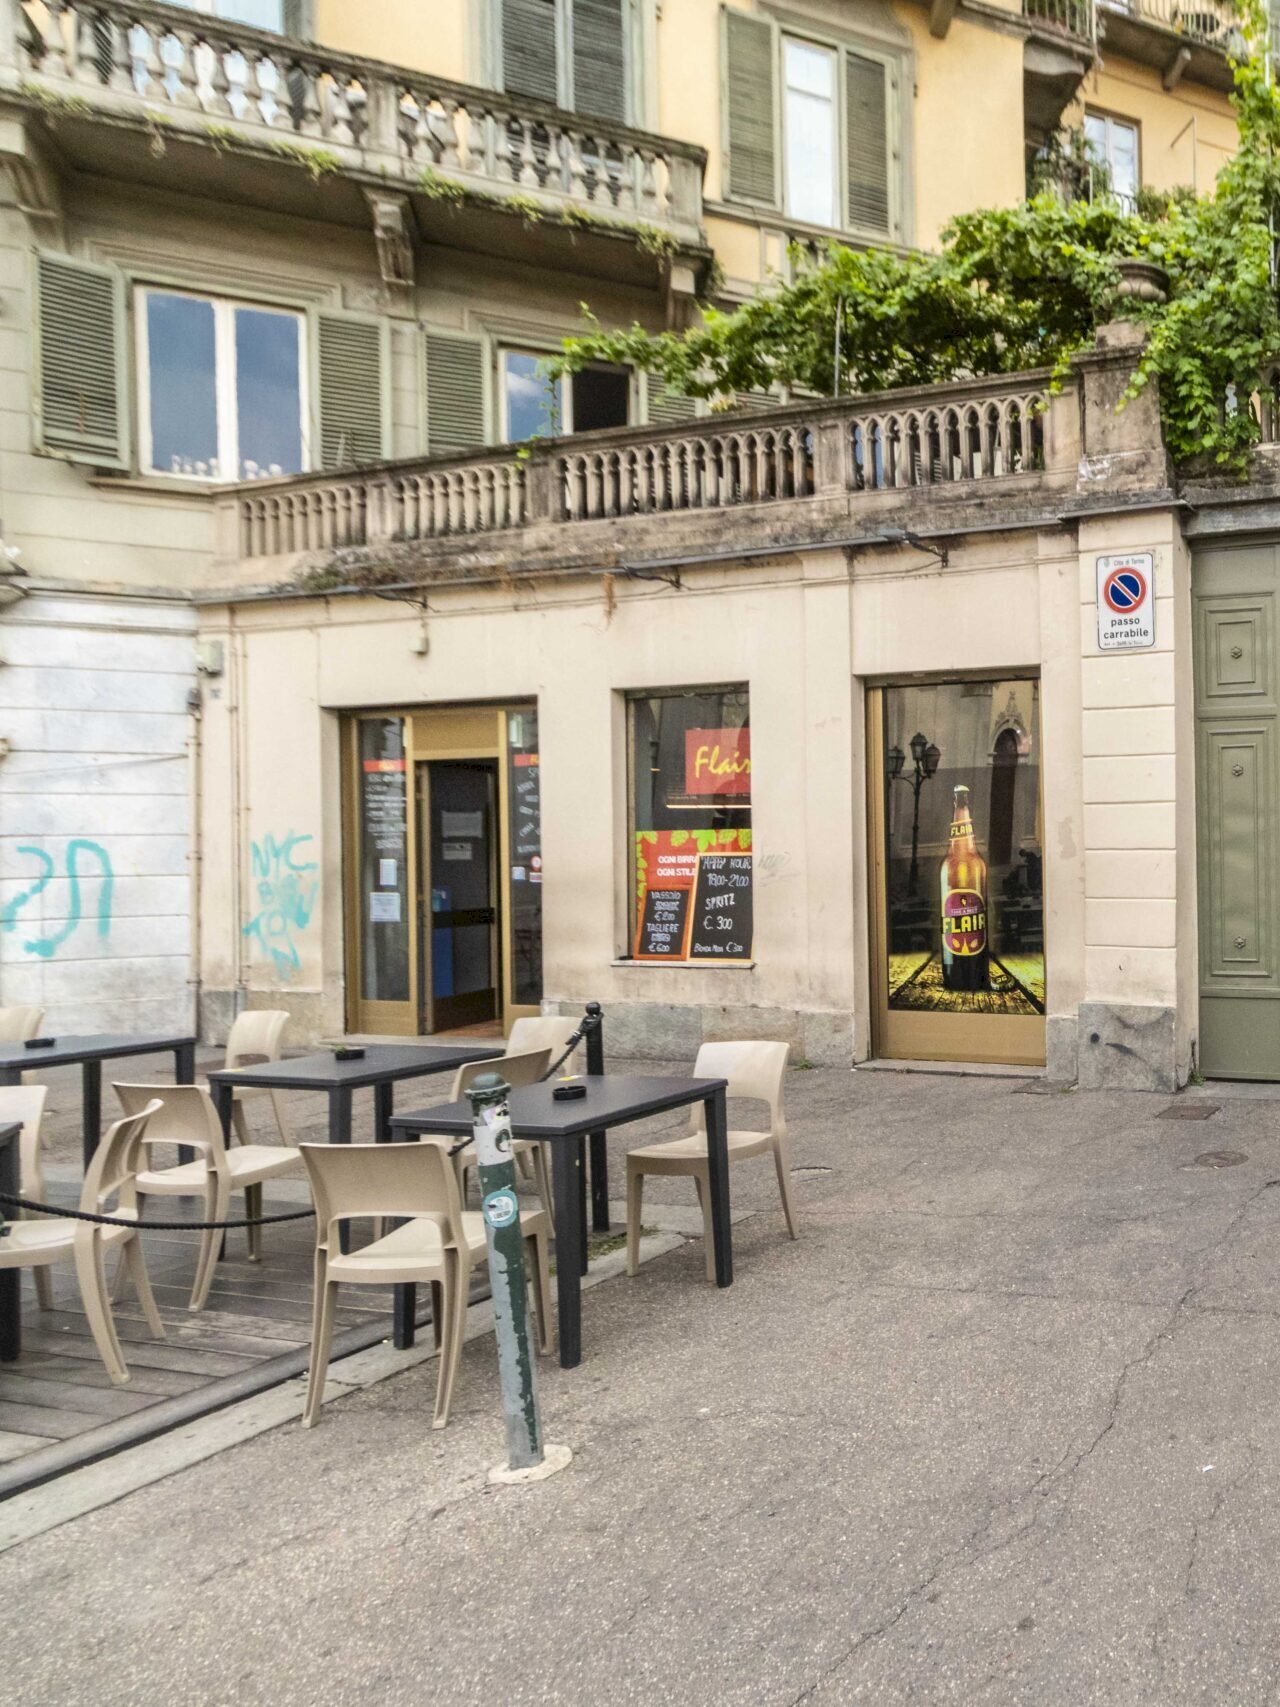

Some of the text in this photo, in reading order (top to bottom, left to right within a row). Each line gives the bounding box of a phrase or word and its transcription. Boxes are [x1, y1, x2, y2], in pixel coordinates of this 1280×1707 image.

[1110, 617, 1140, 628] passo
[1103, 628, 1149, 639] carrabile
[950, 824, 973, 836] FLAIR
[657, 855, 676, 864] OGNI
[656, 868, 675, 877] OGNI
[705, 893, 735, 911] SPRITZ
[943, 913, 986, 934] FLAIR
